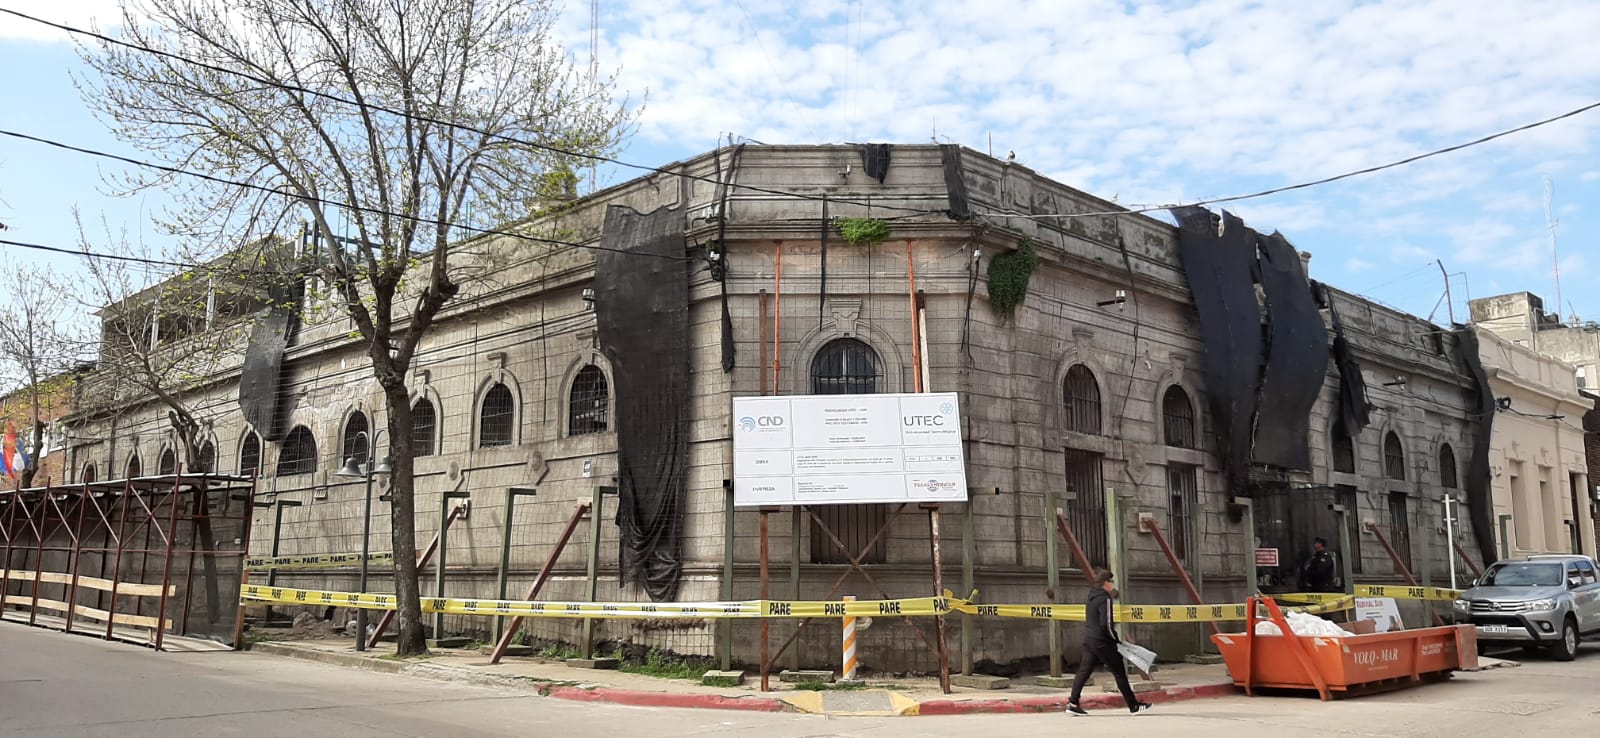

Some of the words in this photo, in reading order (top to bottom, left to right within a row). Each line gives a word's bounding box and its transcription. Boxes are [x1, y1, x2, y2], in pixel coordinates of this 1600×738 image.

[758, 416, 784, 427] CND
[904, 415, 944, 426] UTEC
[1369, 586, 1385, 596] PARE
[1408, 588, 1424, 597] PARE
[769, 602, 791, 615] PARE
[824, 603, 846, 615] PARE
[879, 602, 901, 614] PARE
[977, 606, 998, 616] PARE
[1031, 606, 1052, 617] PARE
